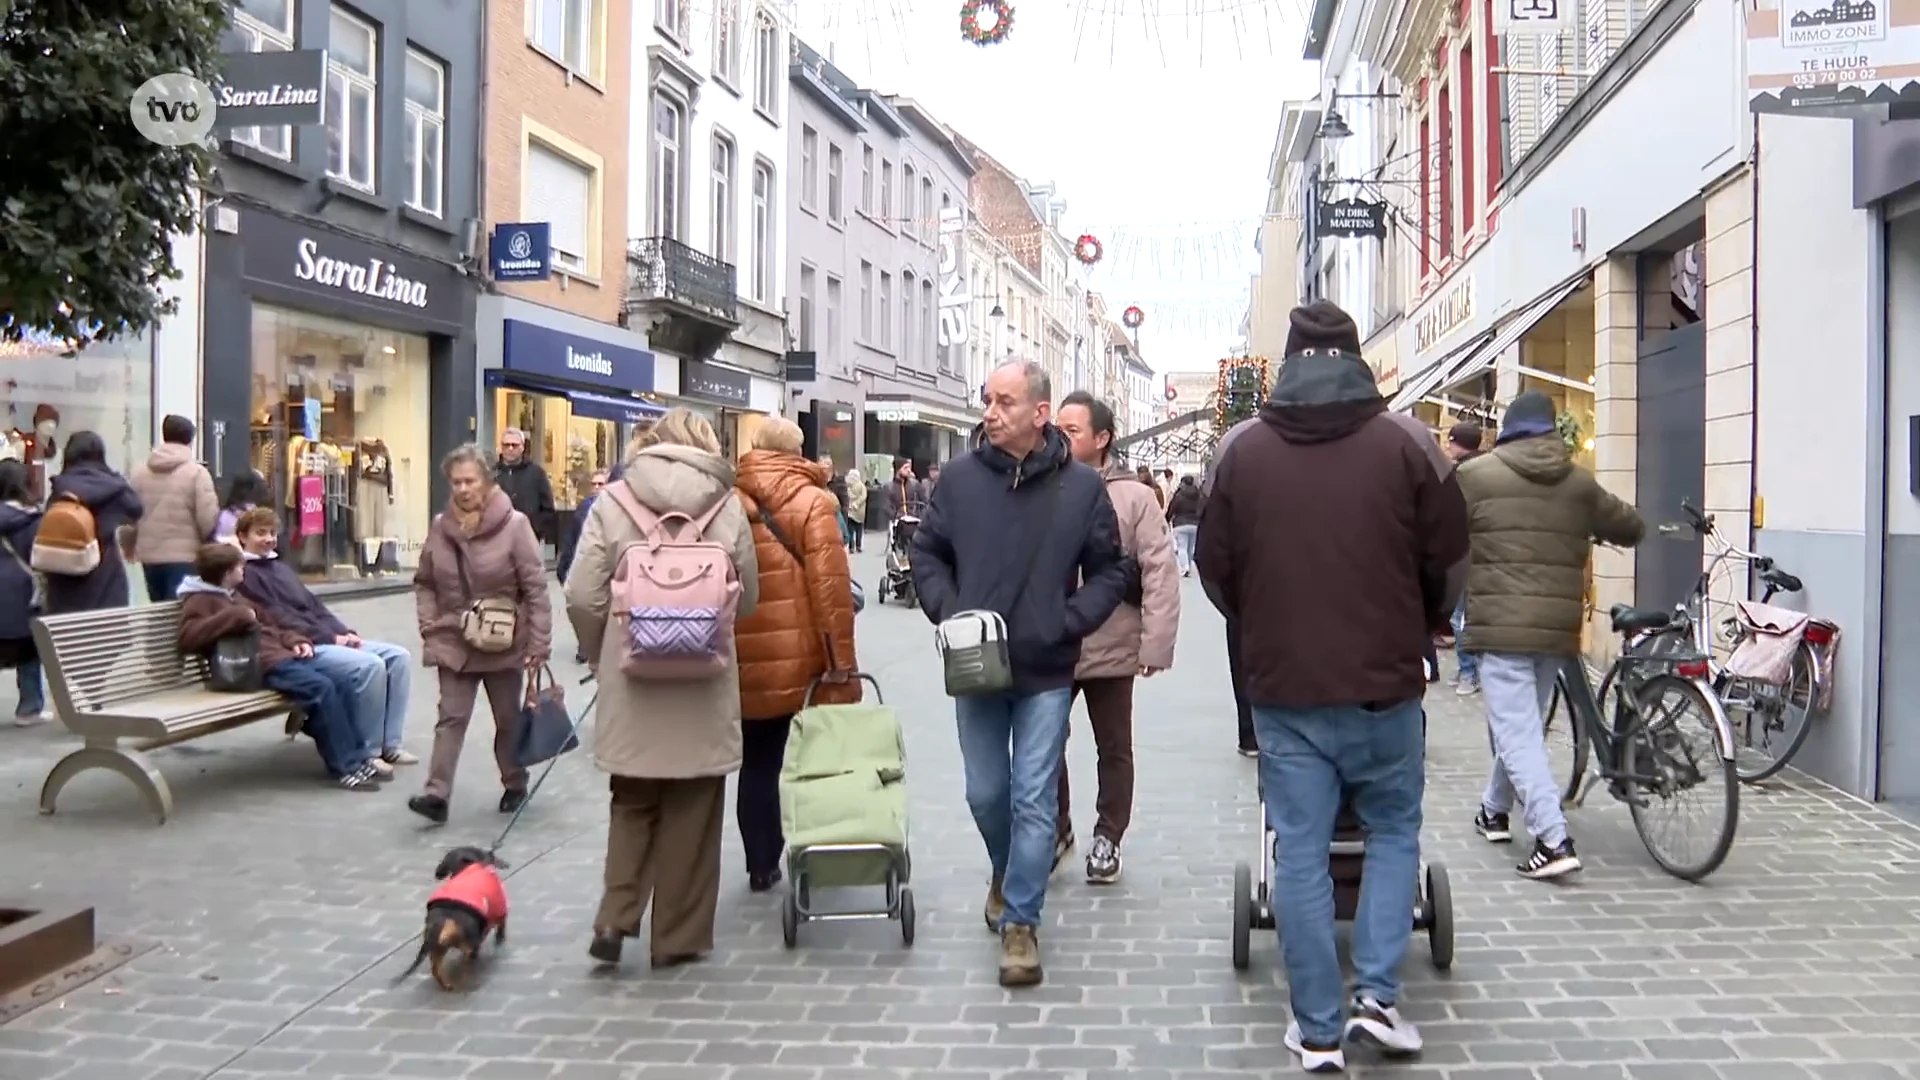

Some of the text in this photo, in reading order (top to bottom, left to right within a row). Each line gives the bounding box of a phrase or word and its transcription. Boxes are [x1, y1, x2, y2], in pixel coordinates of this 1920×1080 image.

[1790, 24, 1877, 43] IMMO ZONE
[1801, 55, 1868, 71] TE HUUR
[1792, 69, 1877, 84] 053 70 00 02
[219, 84, 319, 108] SaraLina
[1334, 208, 1370, 218] IN DIRK
[1329, 219, 1375, 229] MARTENS
[500, 258, 542, 270] Leonidas
[295, 238, 428, 308] SaraLina
[566, 344, 613, 377] Leonidas
